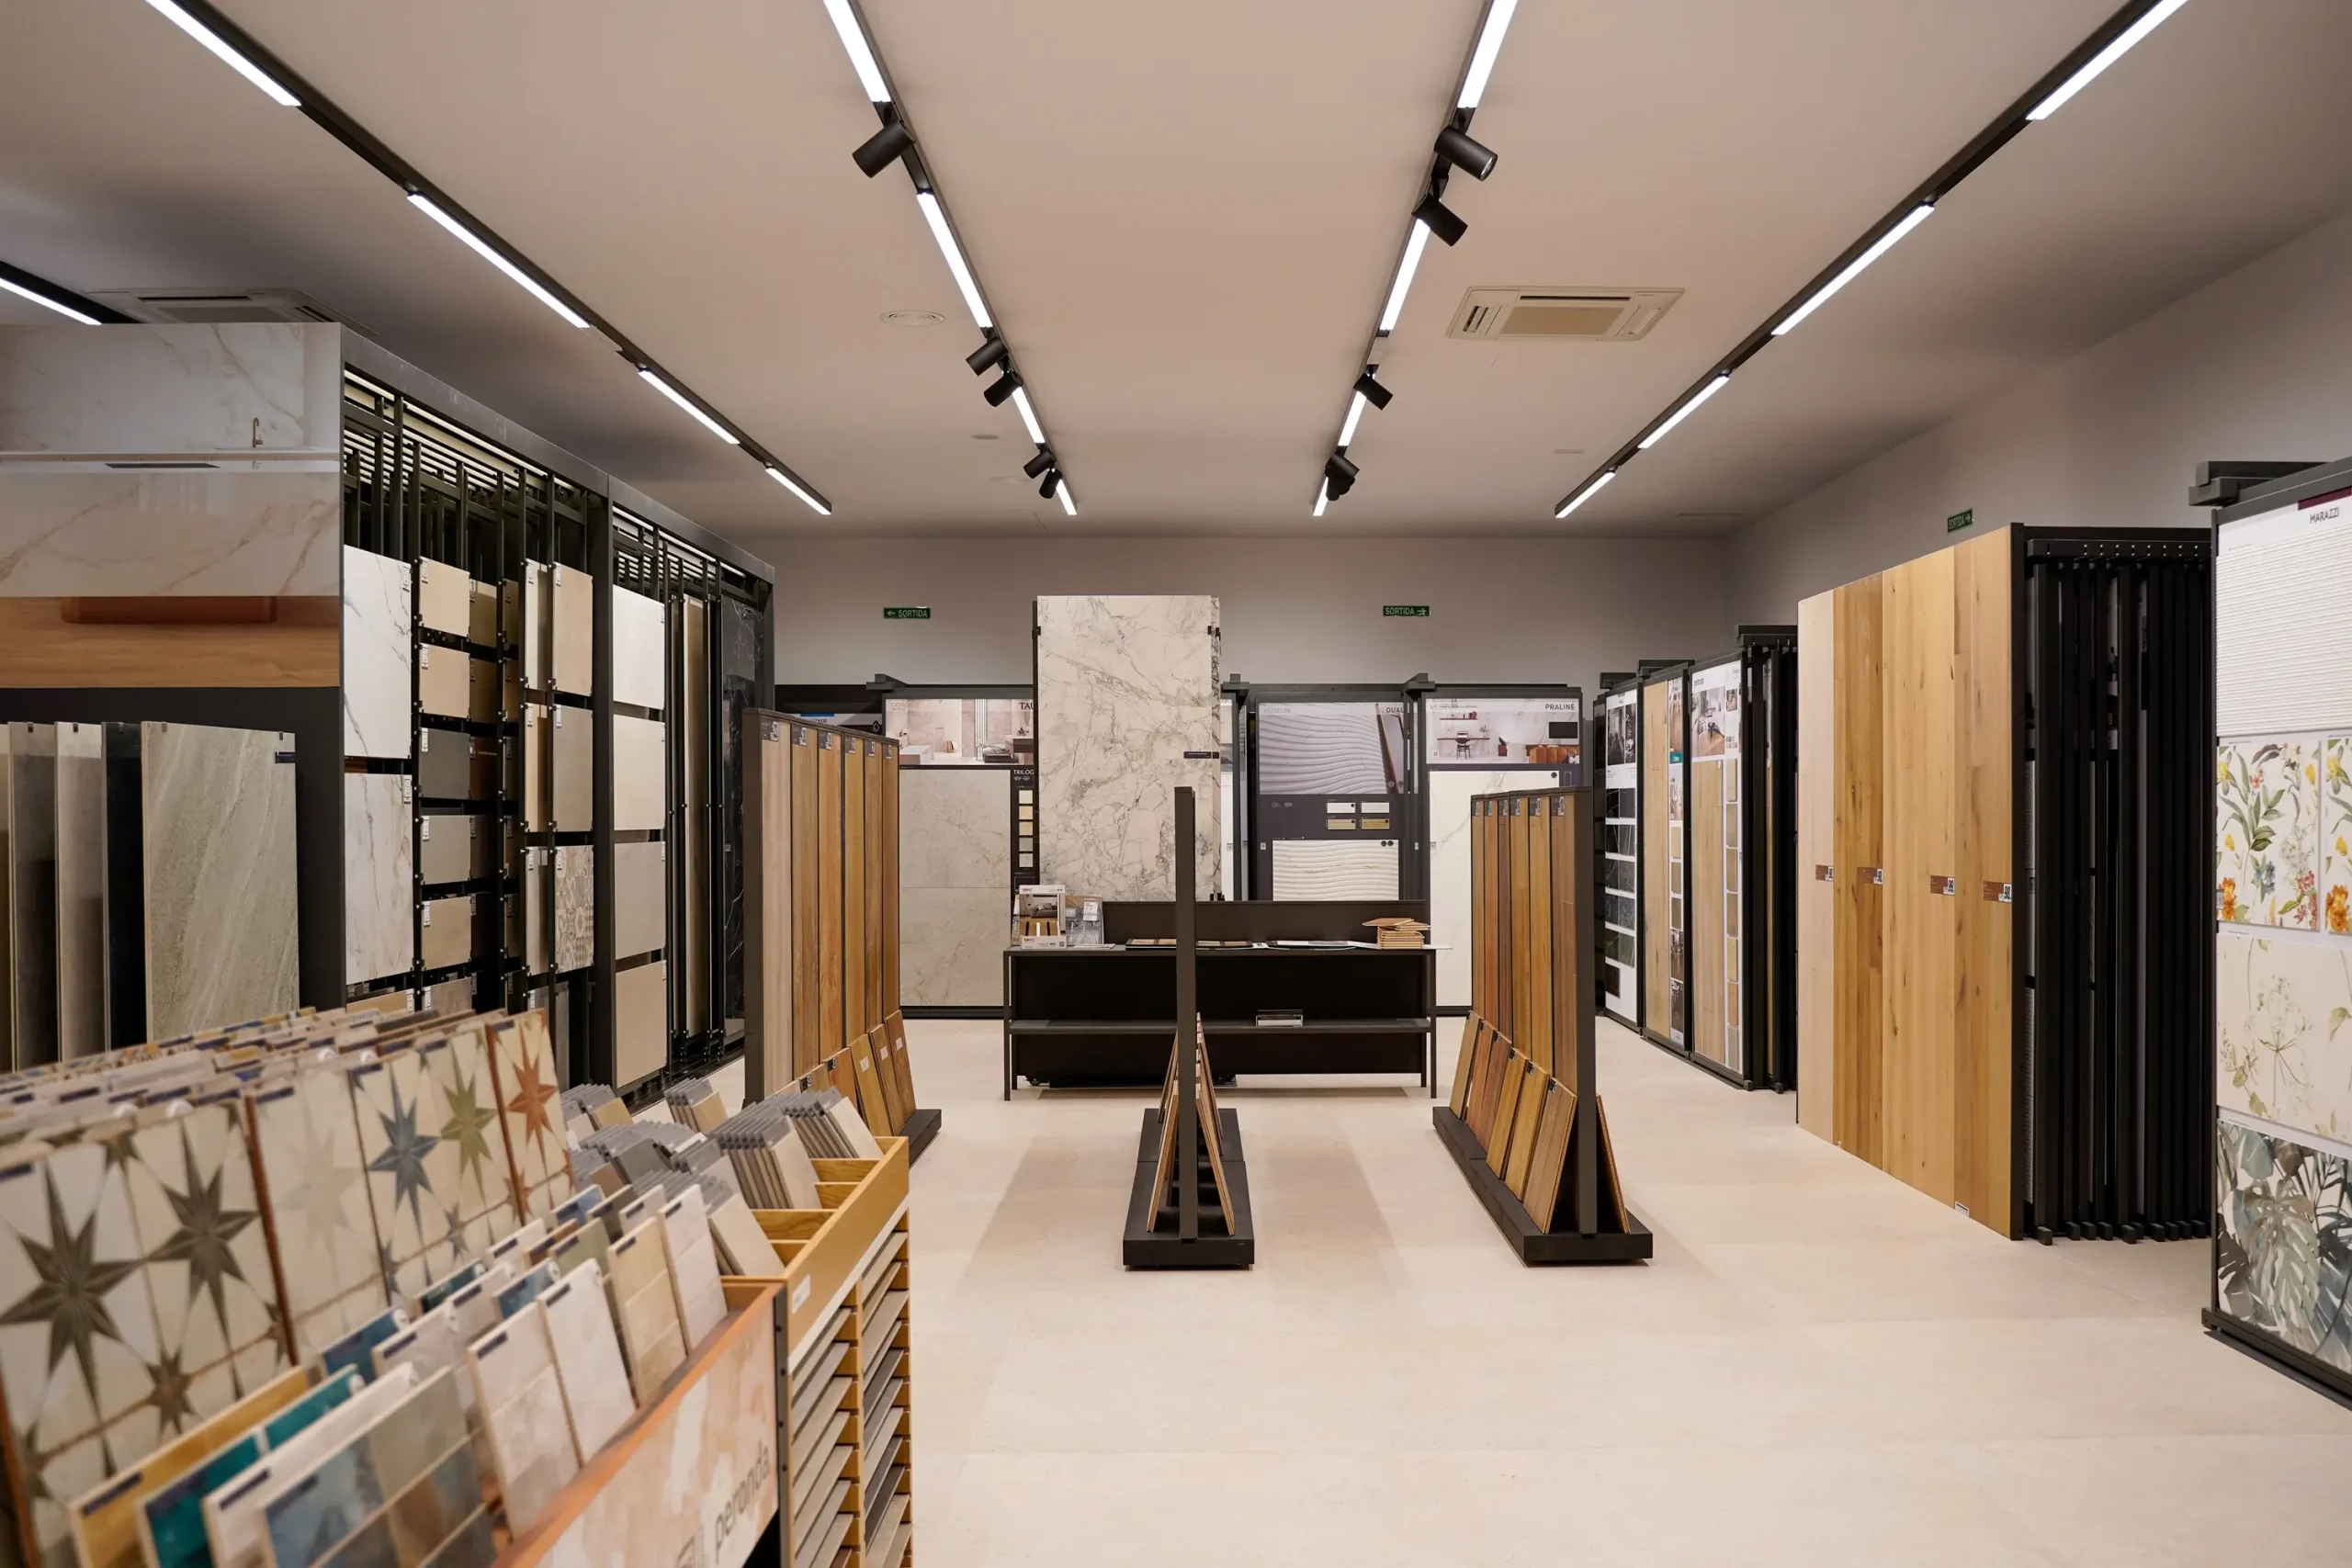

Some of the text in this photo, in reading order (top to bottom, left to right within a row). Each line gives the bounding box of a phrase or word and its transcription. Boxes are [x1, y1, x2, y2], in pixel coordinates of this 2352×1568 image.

[2309, 507, 2339, 524] MARAZZI
[898, 609, 928, 617] SORTIDA
[1385, 607, 1415, 615] SORTIDA
[716, 1441, 769, 1565] peronda
